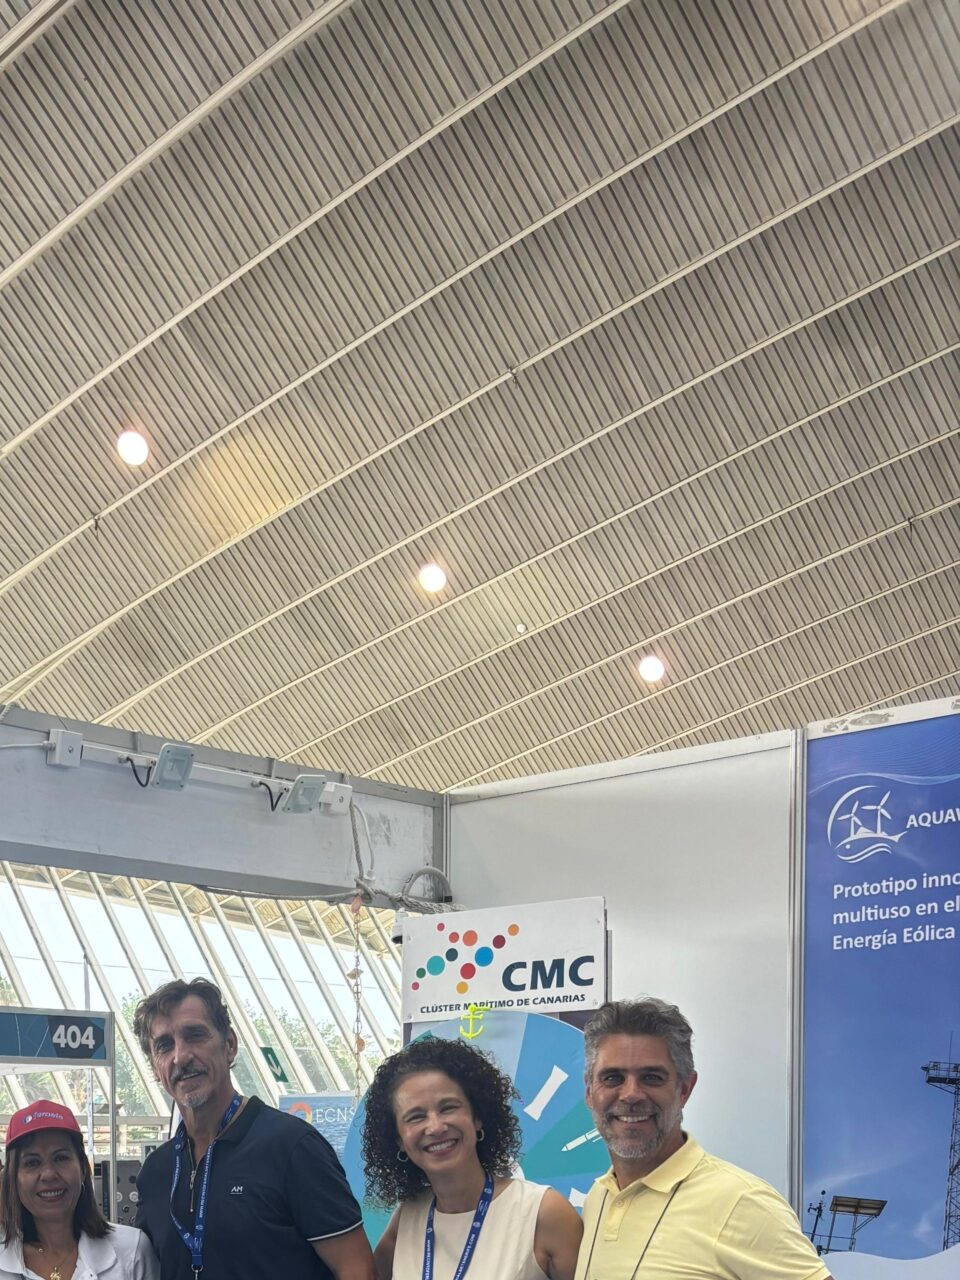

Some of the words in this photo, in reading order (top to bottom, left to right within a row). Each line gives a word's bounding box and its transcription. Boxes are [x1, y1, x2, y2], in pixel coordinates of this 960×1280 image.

[833, 877, 917, 899] Prototipo
[833, 905, 910, 924] multiuso
[916, 902, 938, 916] en
[944, 895, 960, 912] el
[833, 929, 897, 950] Energía
[903, 924, 955, 943] Eólica
[502, 955, 595, 992] CMC
[517, 998, 530, 1006] DE
[533, 994, 586, 1005] CANARIAS
[52, 1025, 95, 1049] 404
